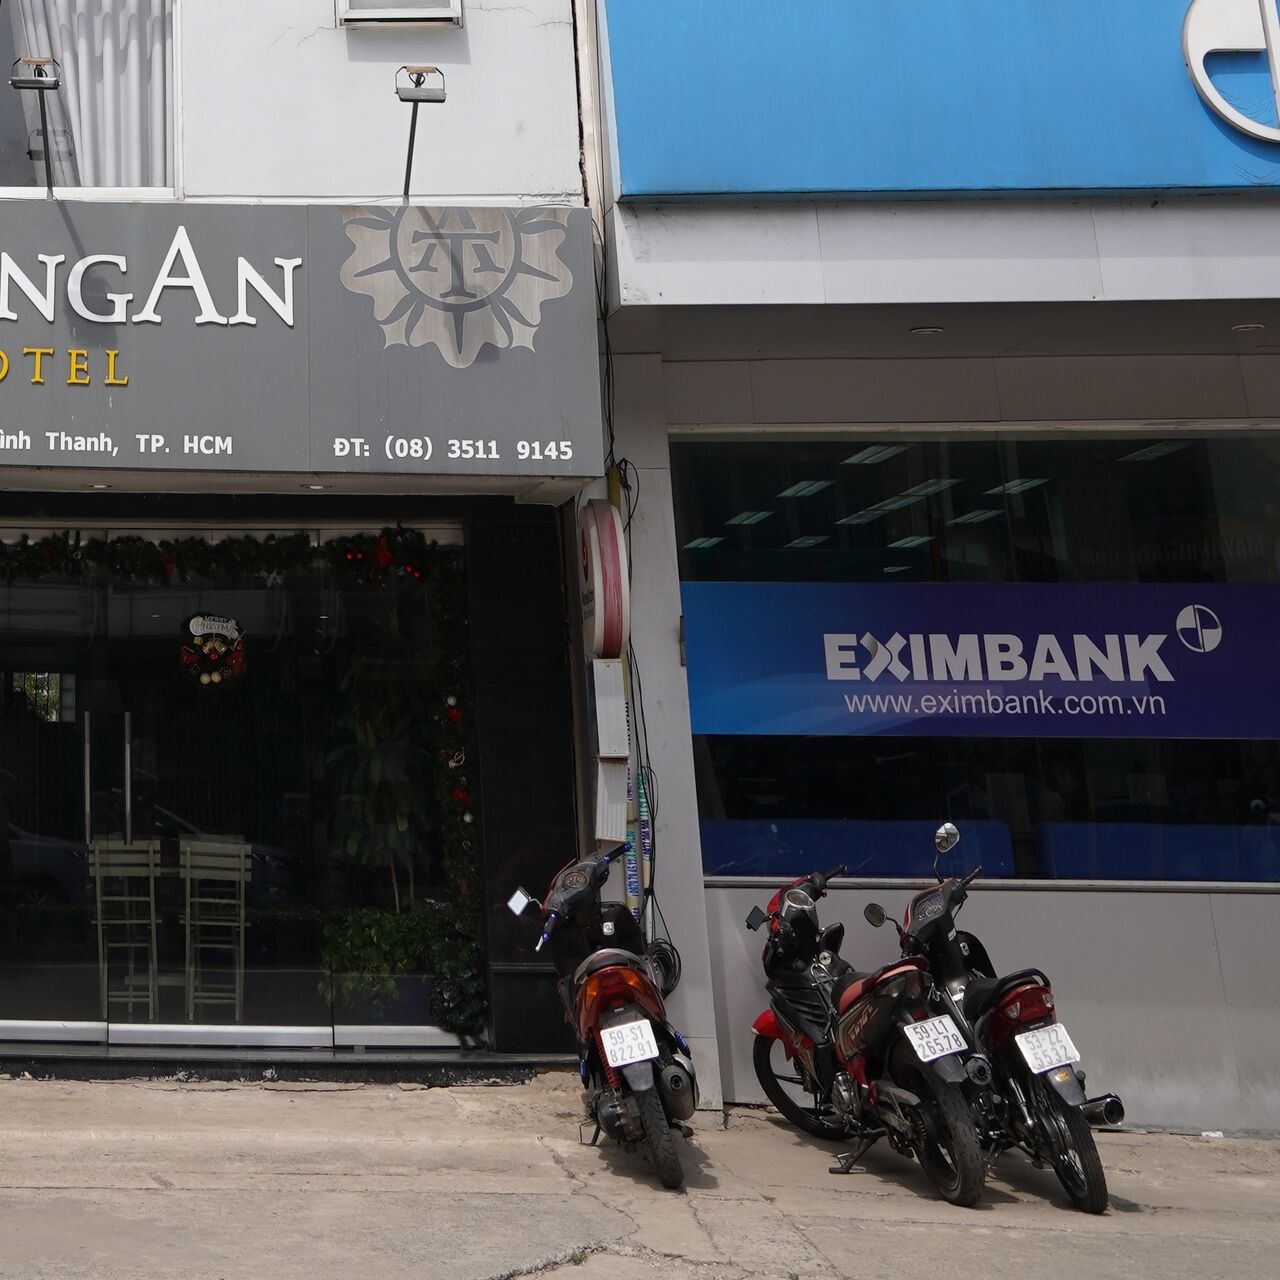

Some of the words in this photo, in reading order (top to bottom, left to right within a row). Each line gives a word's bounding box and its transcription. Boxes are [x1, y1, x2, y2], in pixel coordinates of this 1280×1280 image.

[135, 434, 170, 454] TP.
[183, 435, 234, 455] HCM
[333, 437, 370, 458] ĐT:
[384, 435, 434, 461] (08)
[447, 439, 500, 459] 3511
[516, 440, 574, 460] 9145
[822, 631, 1175, 682] EXIMBANK
[844, 691, 1167, 717] www.eximbank.com.vn
[609, 1025, 644, 1047] 59-S1
[912, 1019, 949, 1041] 59-L1
[918, 1033, 963, 1059] 265.78
